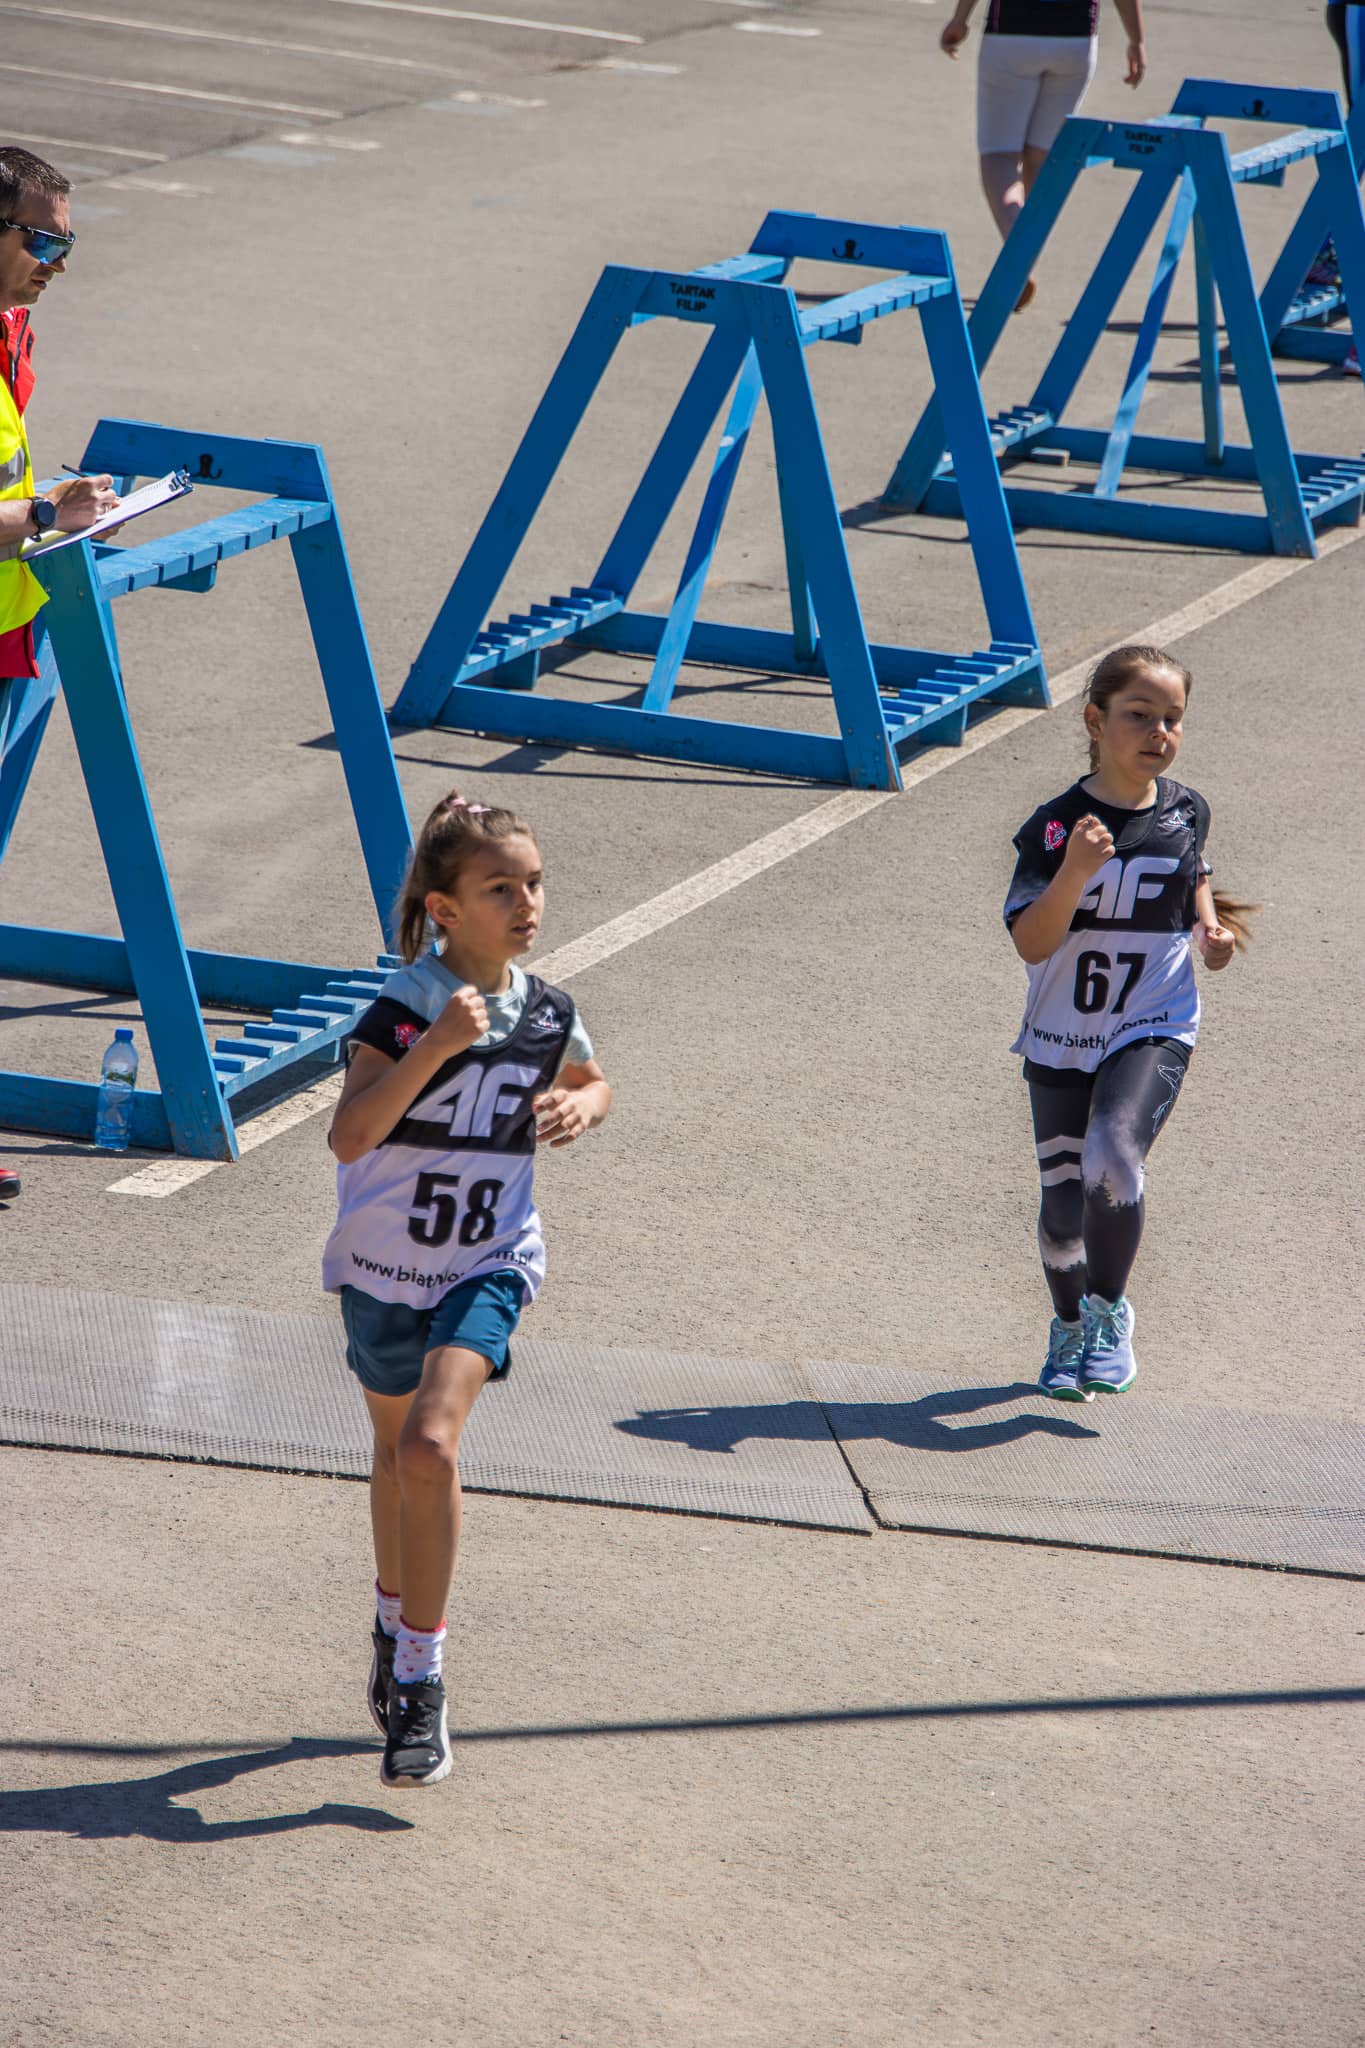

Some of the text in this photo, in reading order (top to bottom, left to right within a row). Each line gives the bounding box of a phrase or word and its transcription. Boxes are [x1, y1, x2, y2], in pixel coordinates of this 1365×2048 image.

[670, 282, 715, 299] TARTAK
[676, 298, 706, 312] FILIP
[1074, 949, 1148, 1015] 67
[406, 1062, 541, 1137] 4F
[407, 1171, 505, 1247] 58
